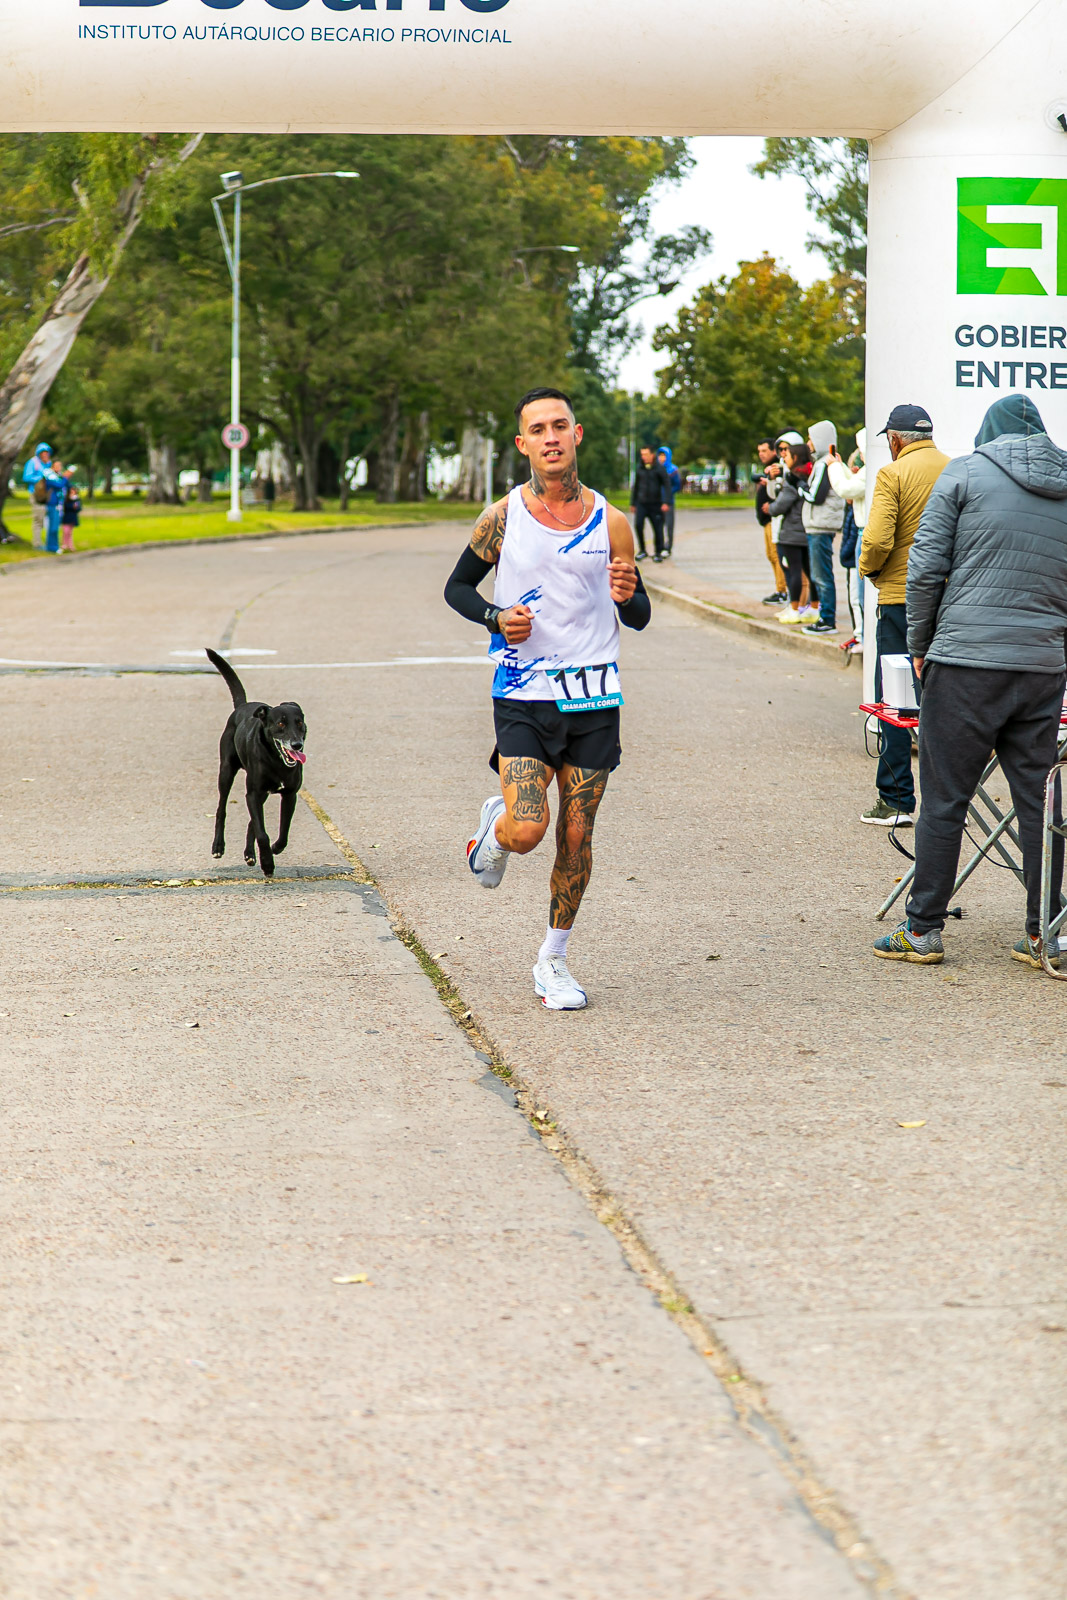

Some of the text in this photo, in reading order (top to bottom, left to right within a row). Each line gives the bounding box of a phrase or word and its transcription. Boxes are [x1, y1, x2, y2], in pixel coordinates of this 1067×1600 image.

[78, 22, 512, 43] INSTITUTO AUTÁRQUICO BECARIO PROVINCIAL
[955, 324, 1067, 349] GOBIER
[956, 360, 1067, 389] ENTRE
[553, 663, 609, 701] 117
[562, 698, 620, 710] DIAMANTE CORRE
